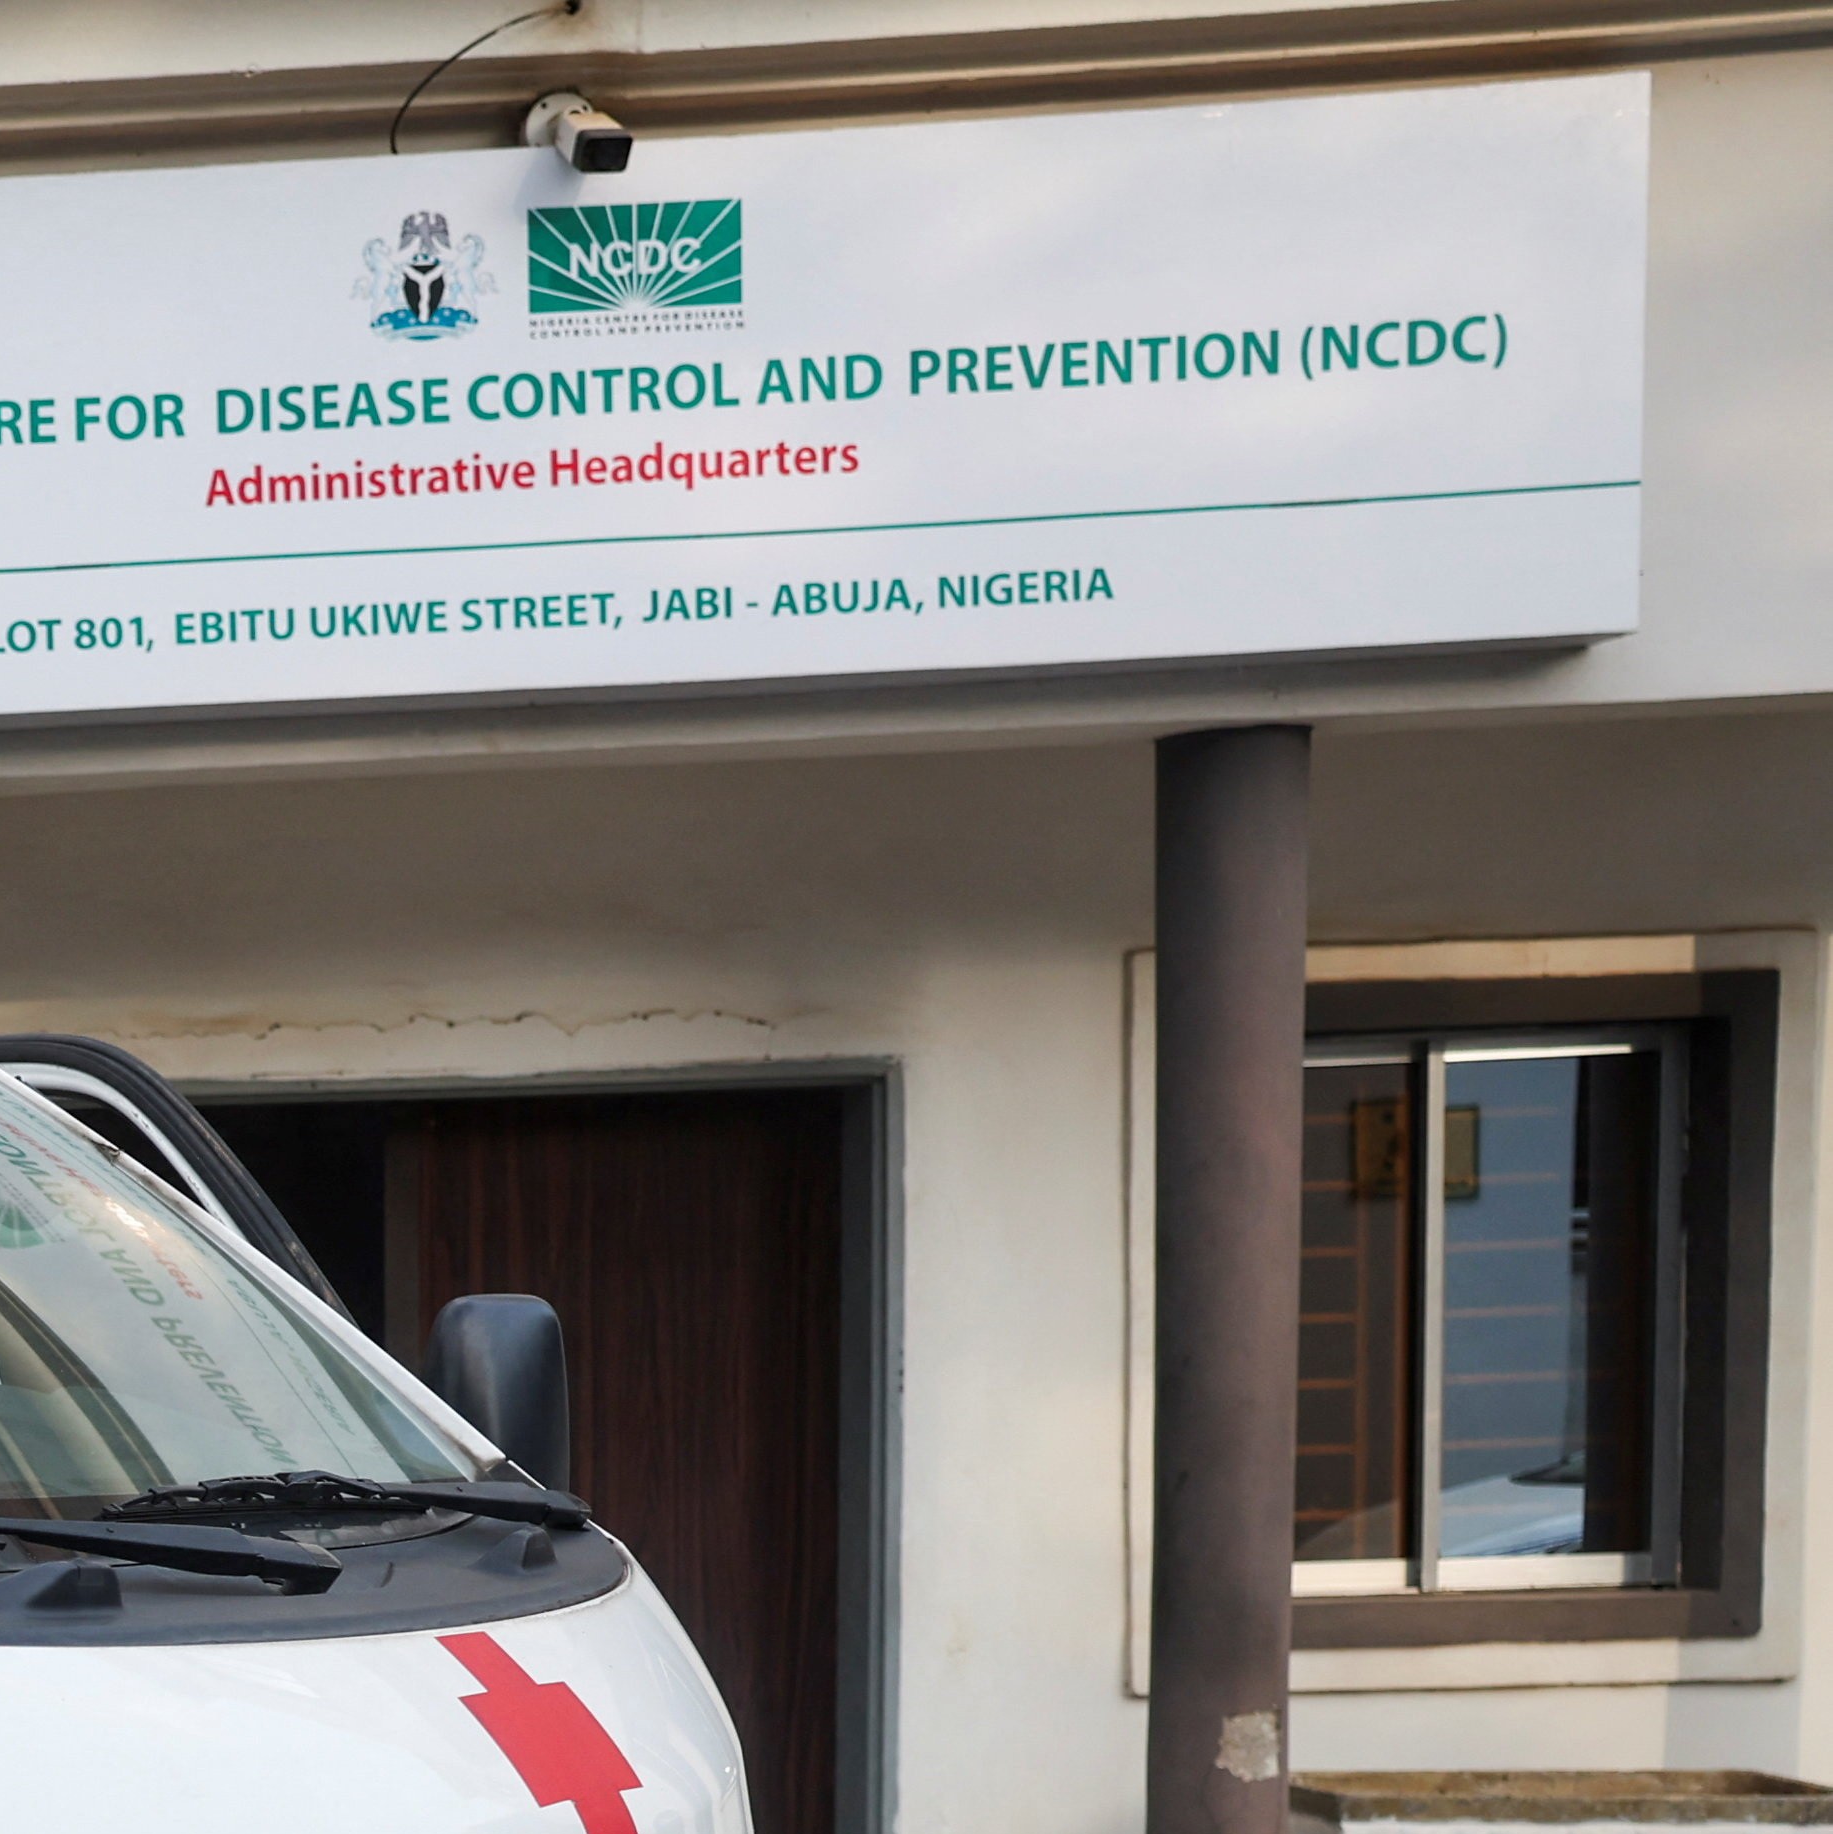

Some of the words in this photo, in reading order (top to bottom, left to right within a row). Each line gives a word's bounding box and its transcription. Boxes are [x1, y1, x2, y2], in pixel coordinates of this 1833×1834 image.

[569, 237, 701, 278] NCDC
[74, 392, 187, 443] FOR
[216, 377, 451, 435] DISEASE
[466, 362, 741, 422] CONTROL
[757, 353, 884, 406] AND
[909, 329, 1280, 396] PREVENTION
[1300, 312, 1509, 381] (NCDC)
[206, 452, 537, 508] Administrative
[550, 441, 861, 491] Headquarters
[72, 614, 155, 653] 801,
[174, 607, 296, 646] EBITU
[309, 599, 448, 639] UKIWE
[460, 592, 623, 634] STREET,
[642, 586, 733, 624] JABI
[771, 577, 925, 617] ABUJA,
[937, 567, 1115, 609] NIGERIA
